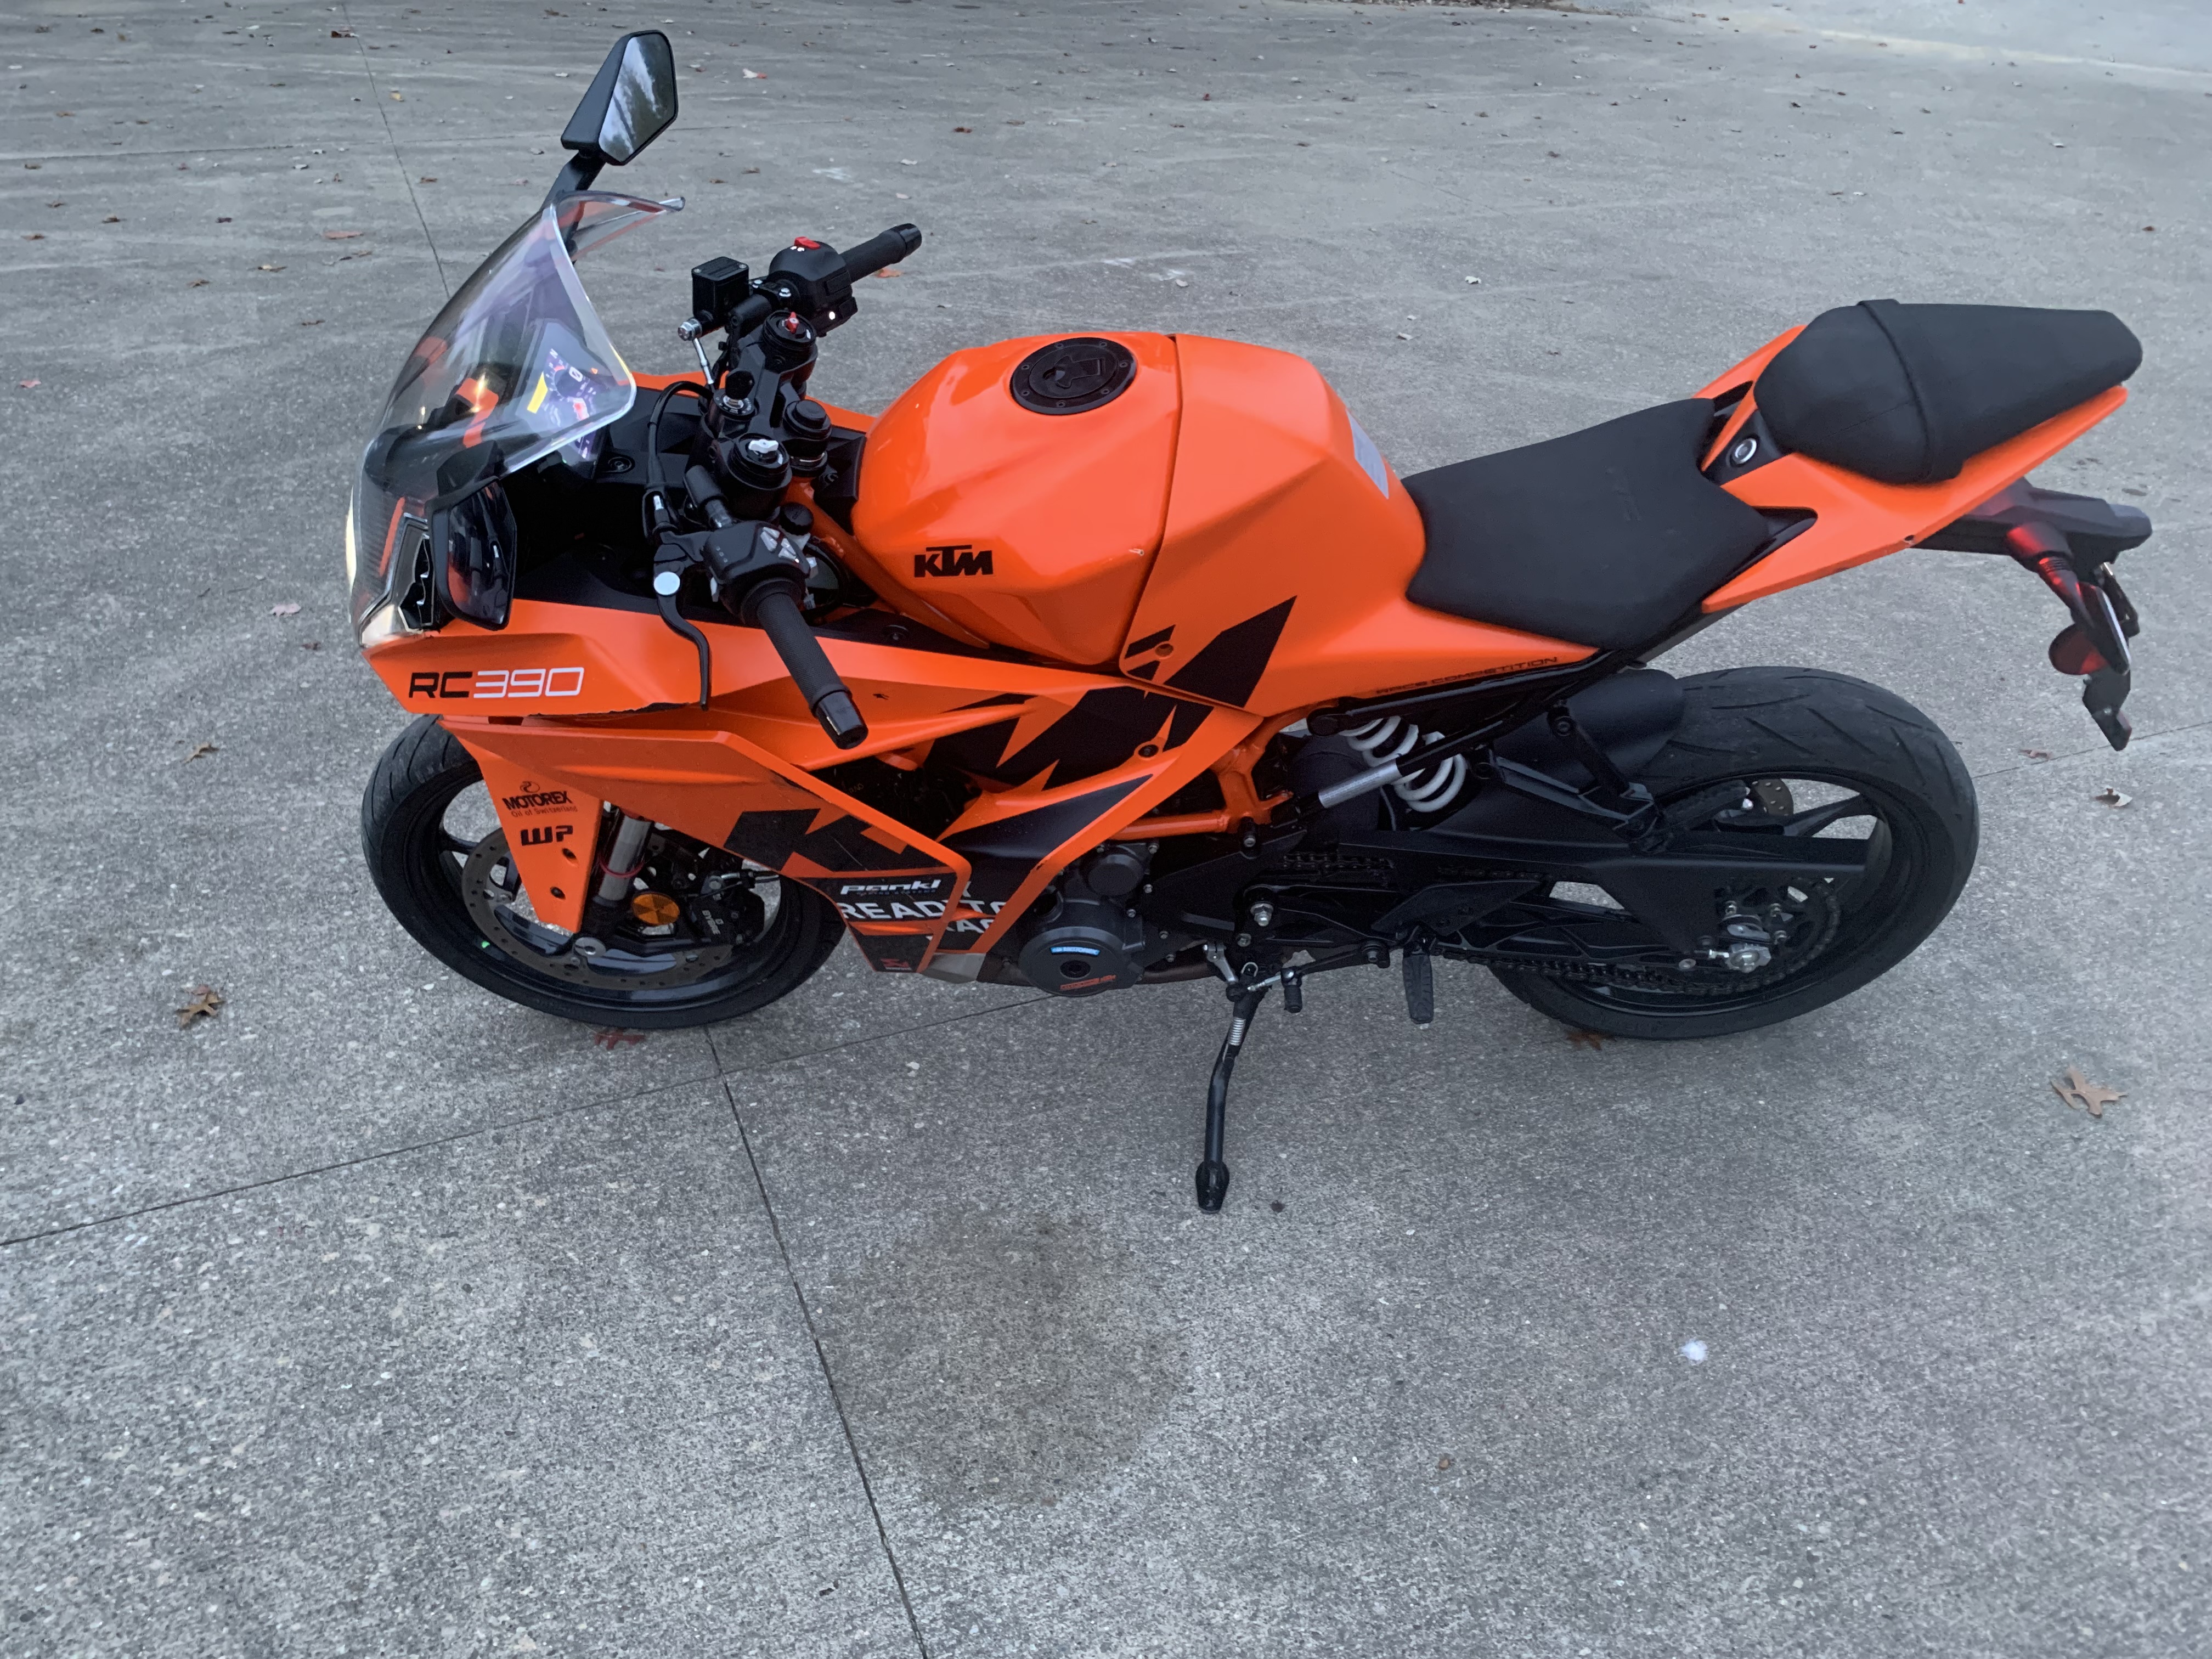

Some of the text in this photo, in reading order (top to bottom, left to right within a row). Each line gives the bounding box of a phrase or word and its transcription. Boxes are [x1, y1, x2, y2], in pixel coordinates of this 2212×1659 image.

[915, 545, 993, 578] KTM
[1431, 657, 1558, 684] COMPETITION
[502, 791, 572, 810] MOTOREX
[534, 805, 578, 815] Switzerland
[521, 825, 573, 846] WP
